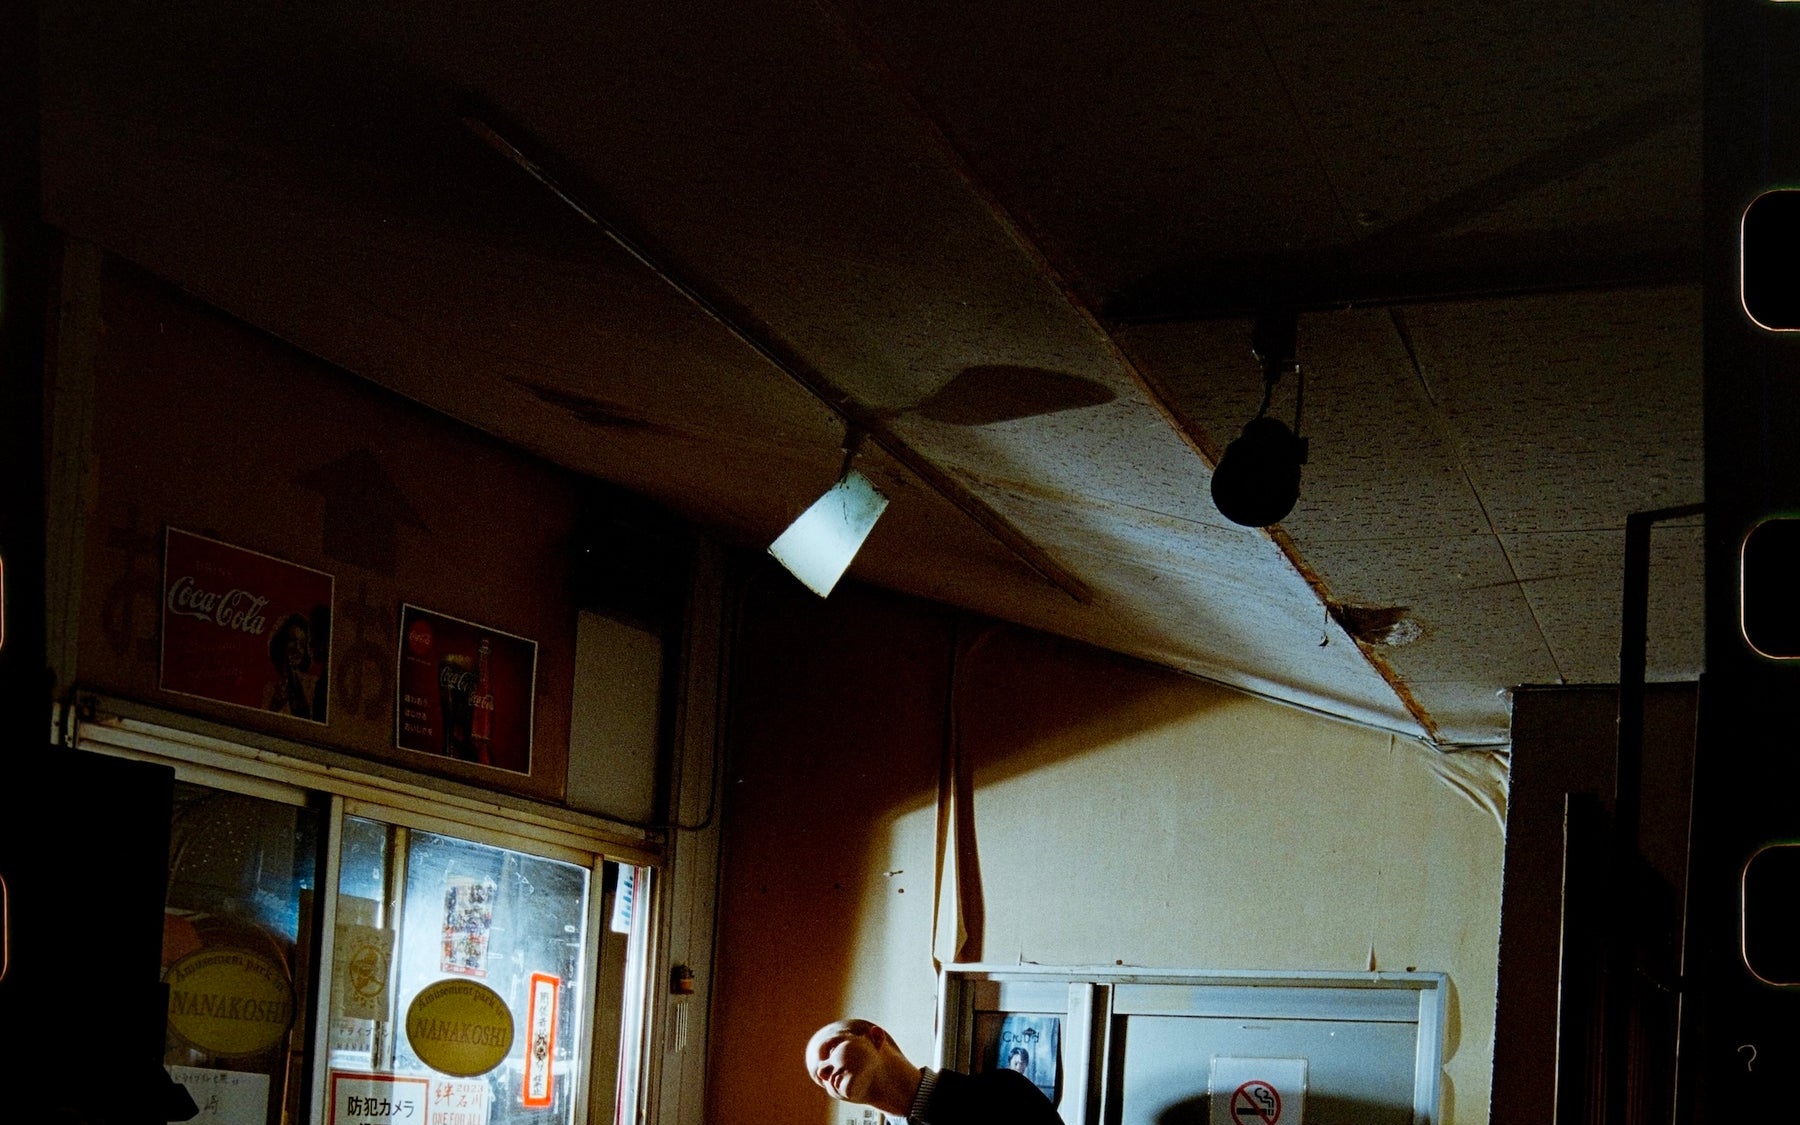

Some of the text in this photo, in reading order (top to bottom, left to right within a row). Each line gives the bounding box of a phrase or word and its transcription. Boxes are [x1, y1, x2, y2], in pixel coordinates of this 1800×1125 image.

[244, 959, 273, 980] park
[171, 990, 289, 1025] NANAKOSHI
[473, 990, 495, 1009] park
[414, 1018, 507, 1047] NANAKOSHI
[456, 1084, 484, 1093] 2023
[347, 1096, 414, 1119] 防犯カメラ
[456, 1094, 482, 1109] 石川
[432, 1112, 447, 1125] ONE
